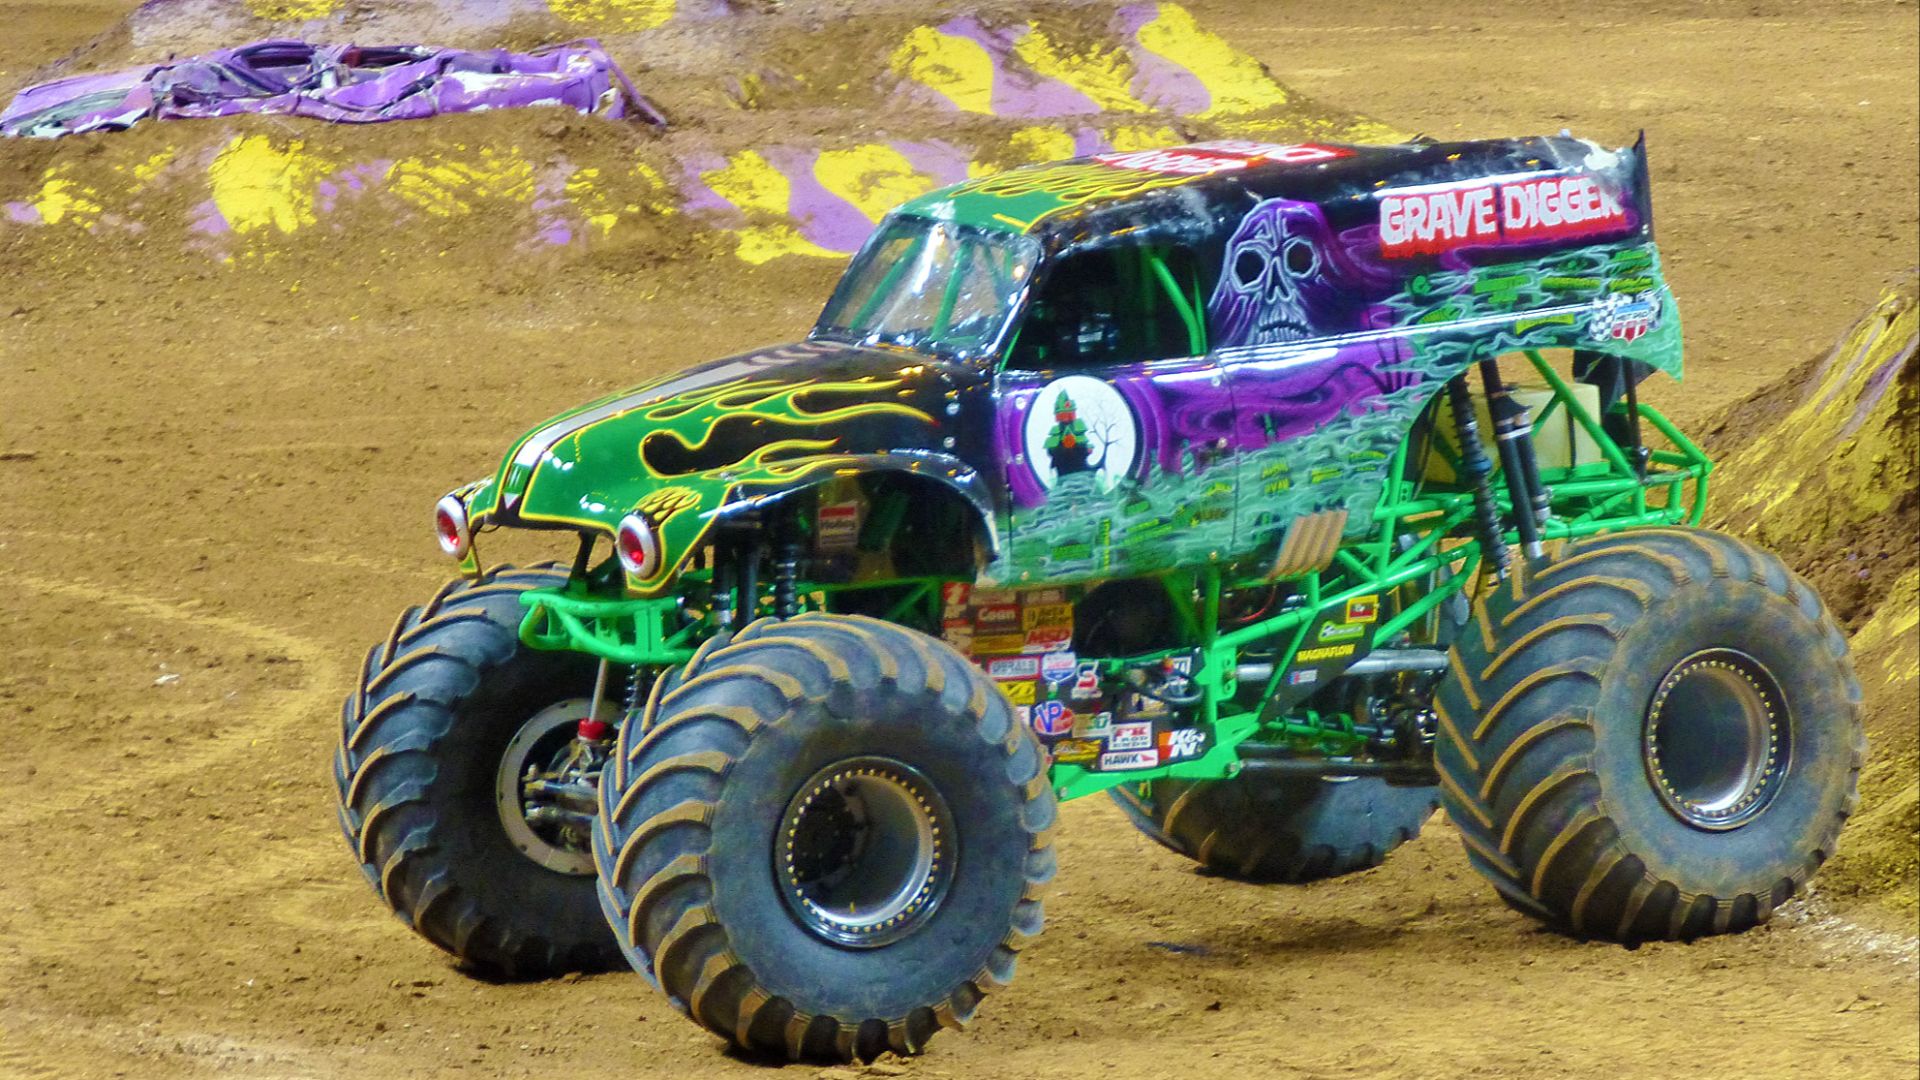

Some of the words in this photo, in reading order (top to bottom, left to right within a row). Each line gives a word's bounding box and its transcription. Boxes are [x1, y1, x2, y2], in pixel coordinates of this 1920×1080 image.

[1379, 187, 1497, 245] GRAVE
[1503, 177, 1625, 229] DIGGER
[1296, 644, 1356, 663] MAGNAFLOW
[1035, 701, 1064, 733] VP
[1104, 753, 1139, 766] HAWK
